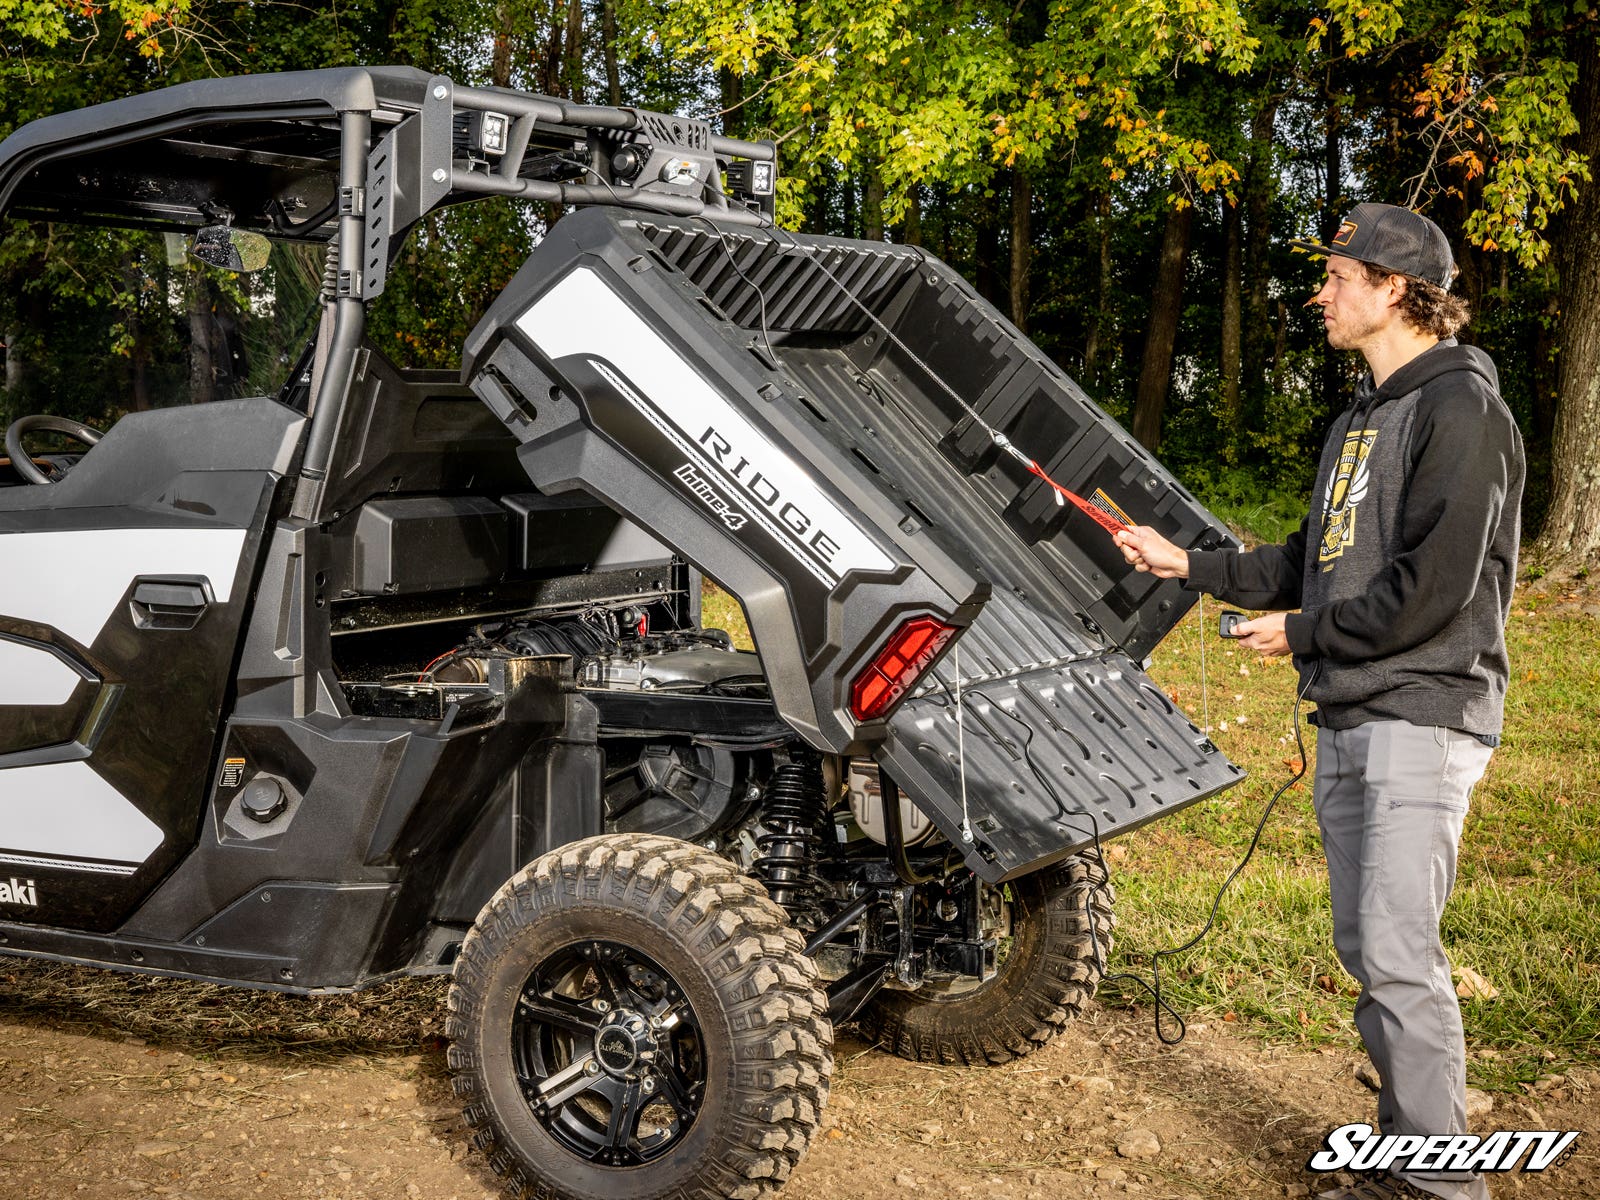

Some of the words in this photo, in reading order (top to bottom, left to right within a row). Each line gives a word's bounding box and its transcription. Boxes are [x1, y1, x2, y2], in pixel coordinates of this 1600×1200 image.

[673, 462, 748, 531] Inline-4
[699, 426, 841, 563] RIDGE
[1082, 504, 1121, 534] SUPERAT
[0, 877, 37, 906] aki
